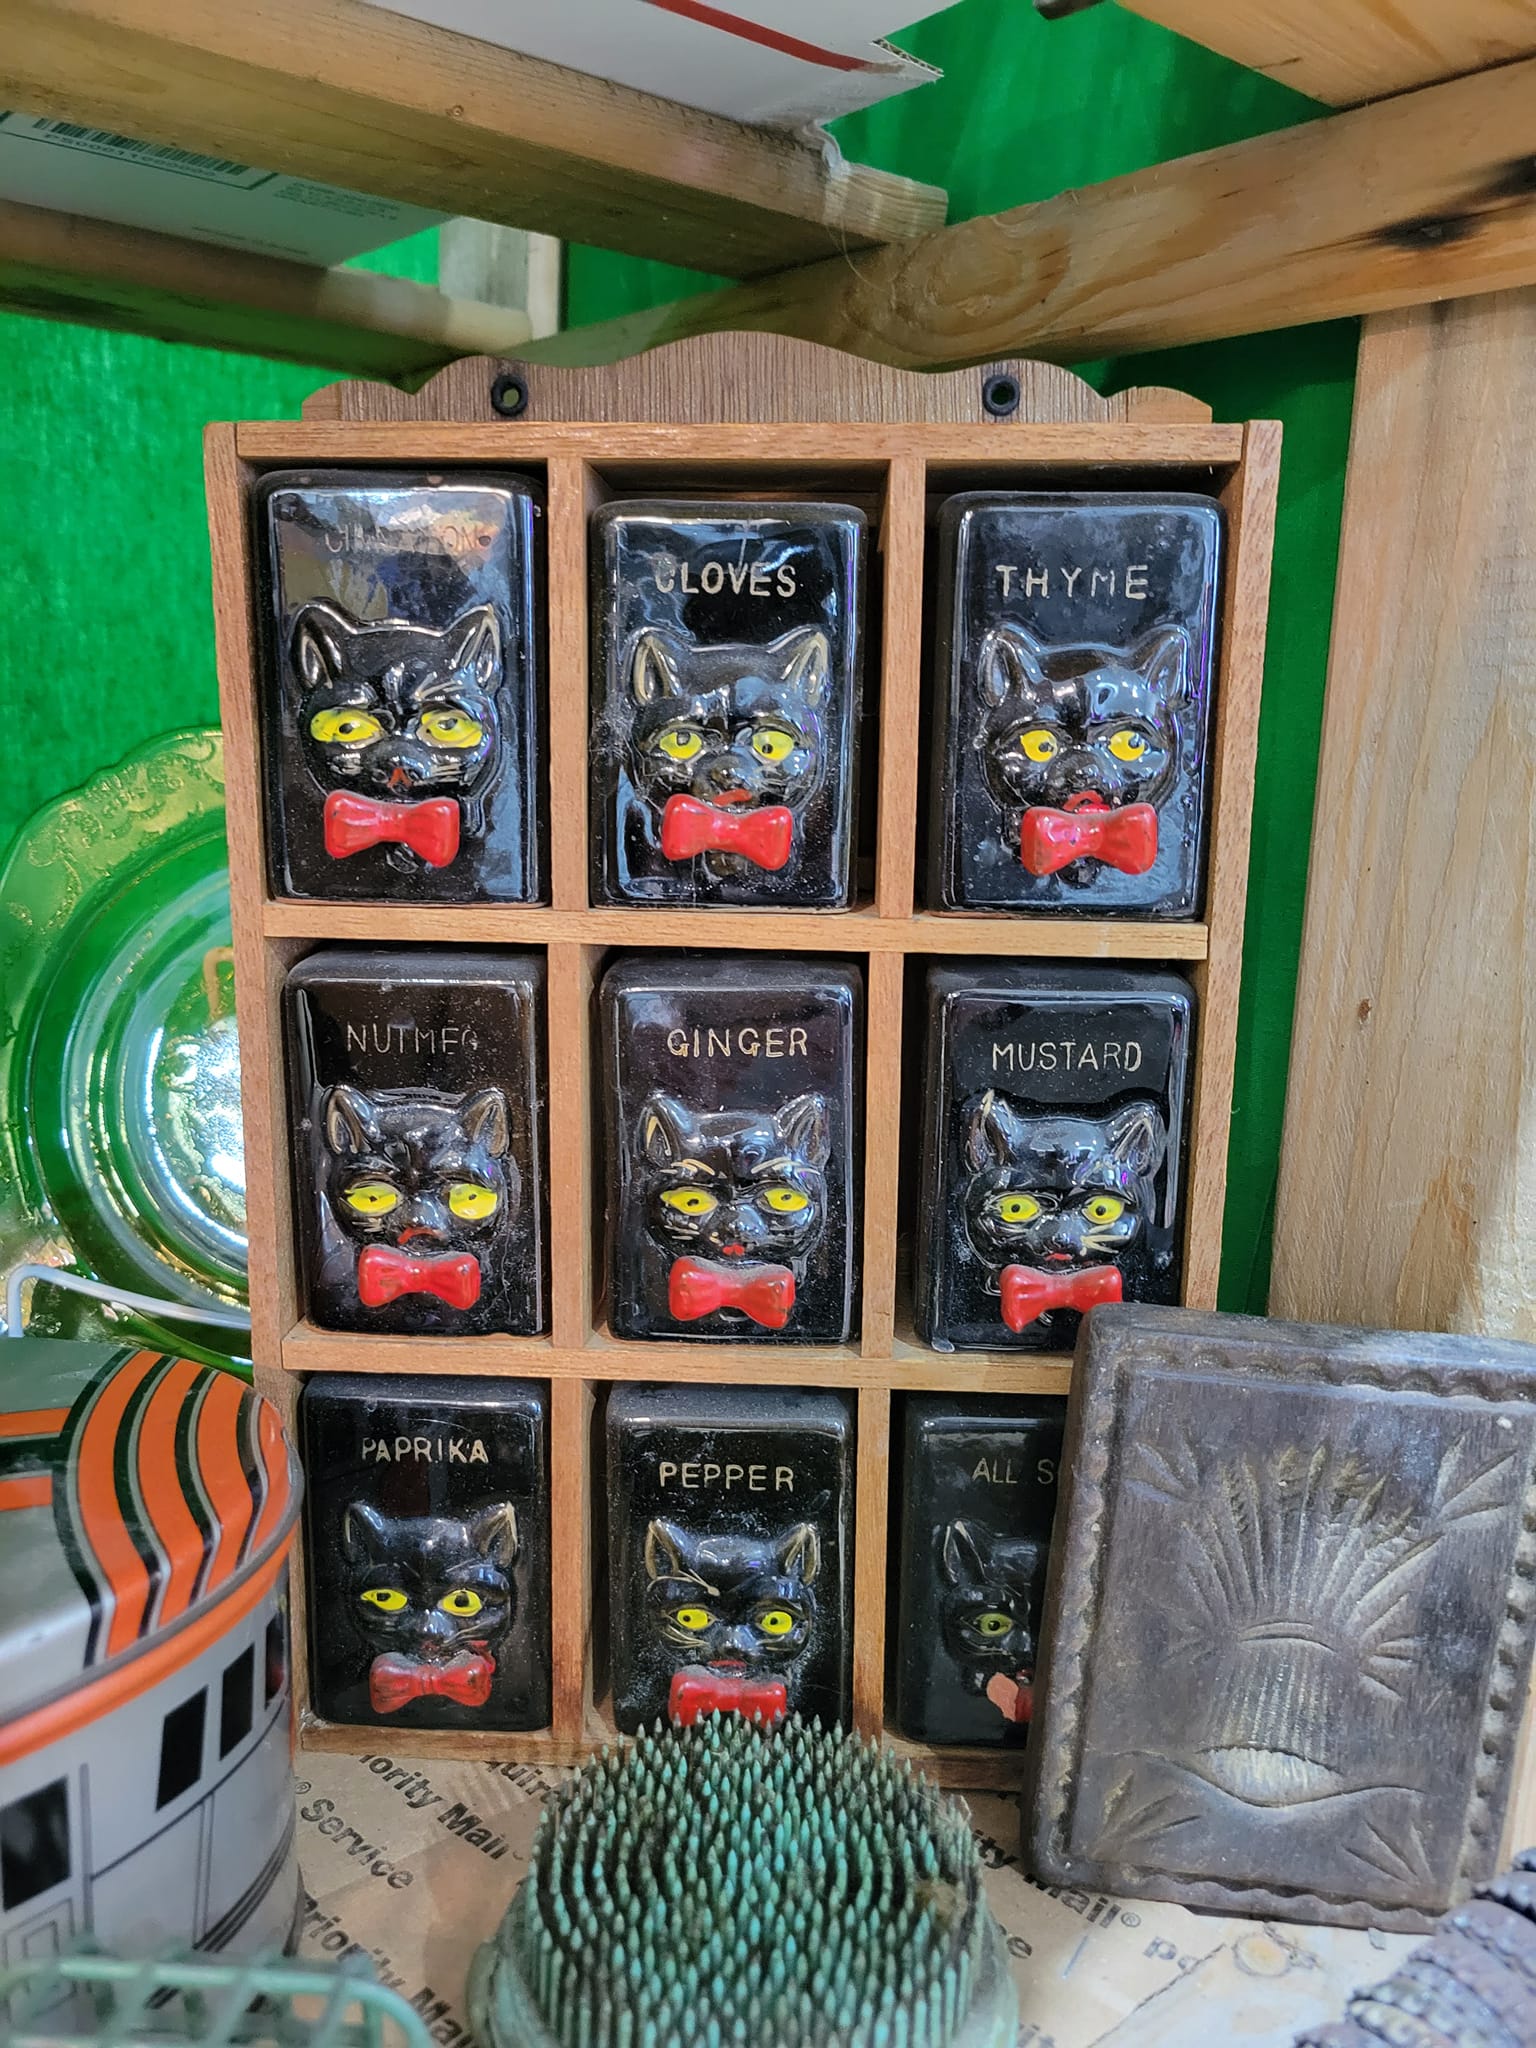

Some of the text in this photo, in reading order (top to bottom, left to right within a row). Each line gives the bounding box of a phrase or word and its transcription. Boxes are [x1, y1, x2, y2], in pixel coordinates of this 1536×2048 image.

[655, 560, 797, 598] CLOVES
[995, 564, 1149, 600] THYME
[347, 1022, 478, 1054] NUTMEG
[667, 1027, 808, 1058] GINGER
[992, 1041, 1143, 1072] MUSTARD
[361, 1436, 489, 1463] PAPRIKA
[659, 1461, 794, 1492] PEPPER
[971, 1457, 1018, 1484] ALL
[300, 1798, 415, 1889] Service
